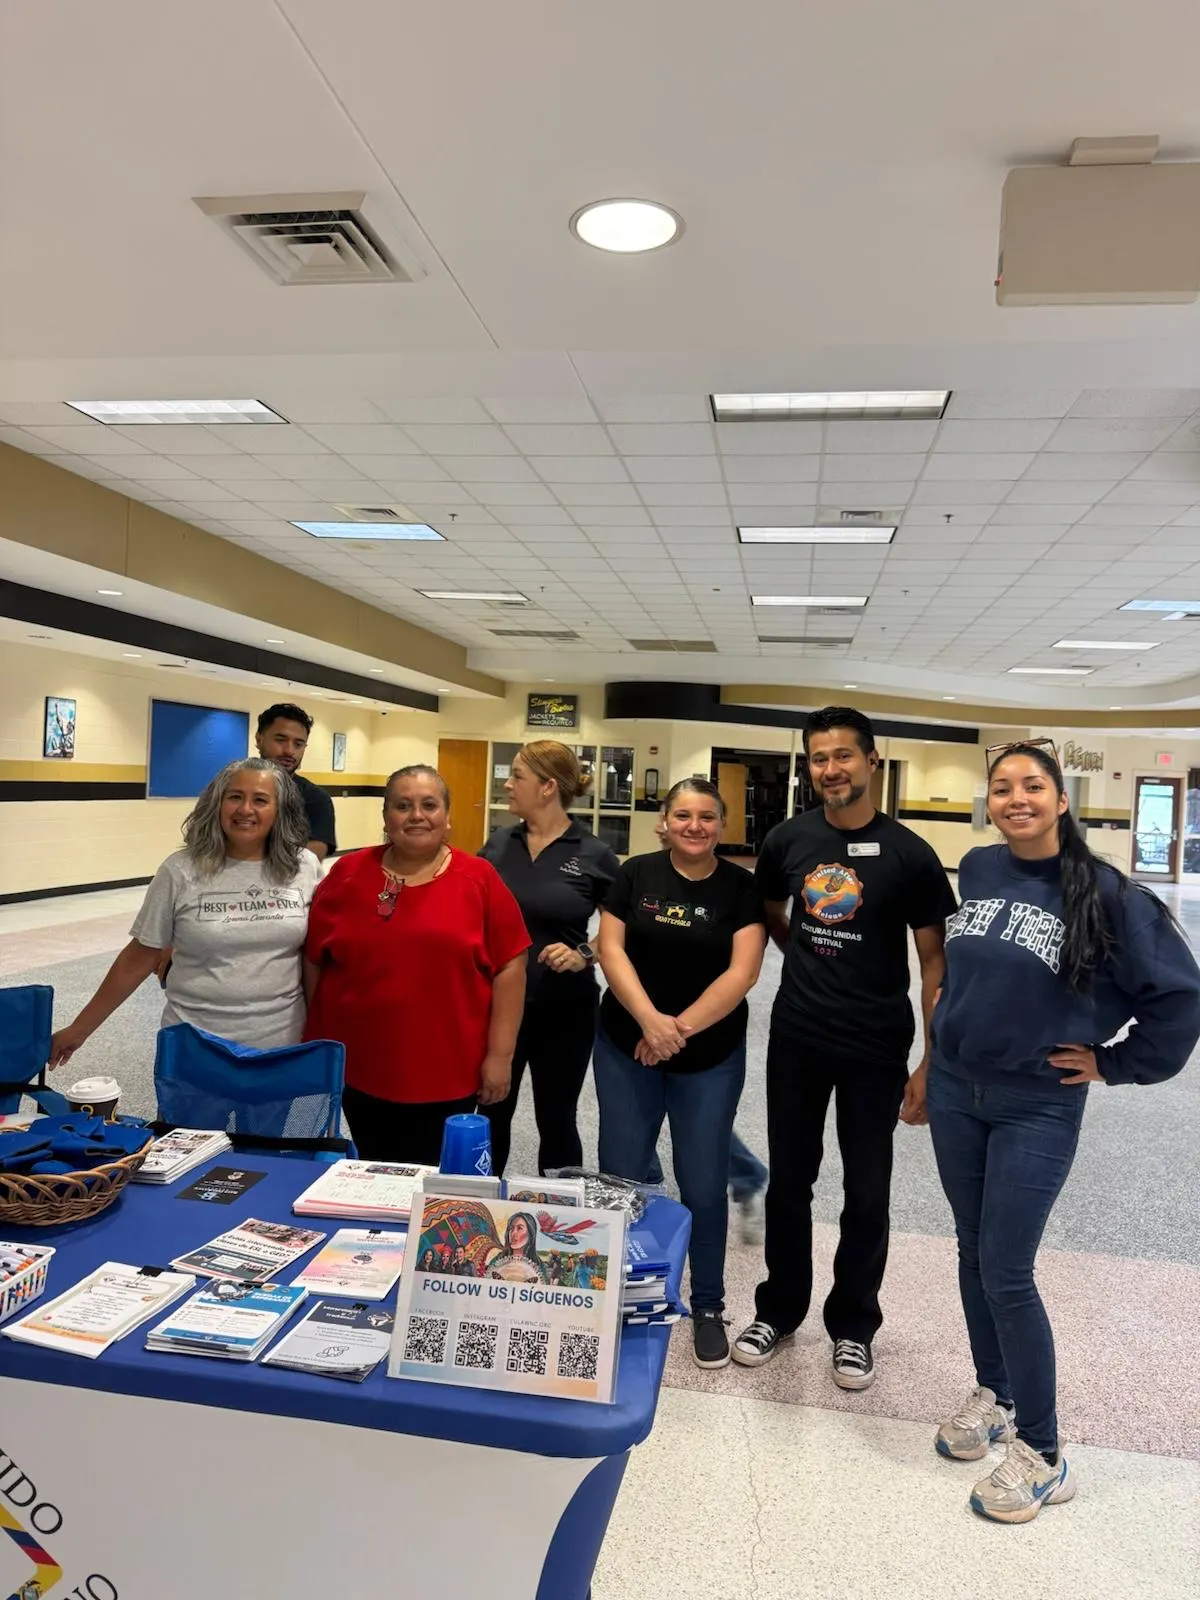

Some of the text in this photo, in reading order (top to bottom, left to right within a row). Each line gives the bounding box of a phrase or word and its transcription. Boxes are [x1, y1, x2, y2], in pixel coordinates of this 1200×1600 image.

[811, 867, 837, 883] United
[203, 899, 301, 913] BEST TEAM EVER
[815, 907, 843, 920] Helene
[801, 922, 863, 942] CULTURAS UNIDAS
[1000, 902, 1066, 975] YORK
[811, 935, 844, 949] FESTIVAL
[422, 1278, 482, 1297] FOLLOW
[488, 1285, 508, 1300] US
[519, 1286, 594, 1310] SÍGUENOS
[415, 1308, 445, 1316] FACEBOOK
[463, 1313, 497, 1322] INSTAGRAM
[568, 1325, 595, 1333] YOUTUBE
[0, 1447, 63, 1535] IDO
